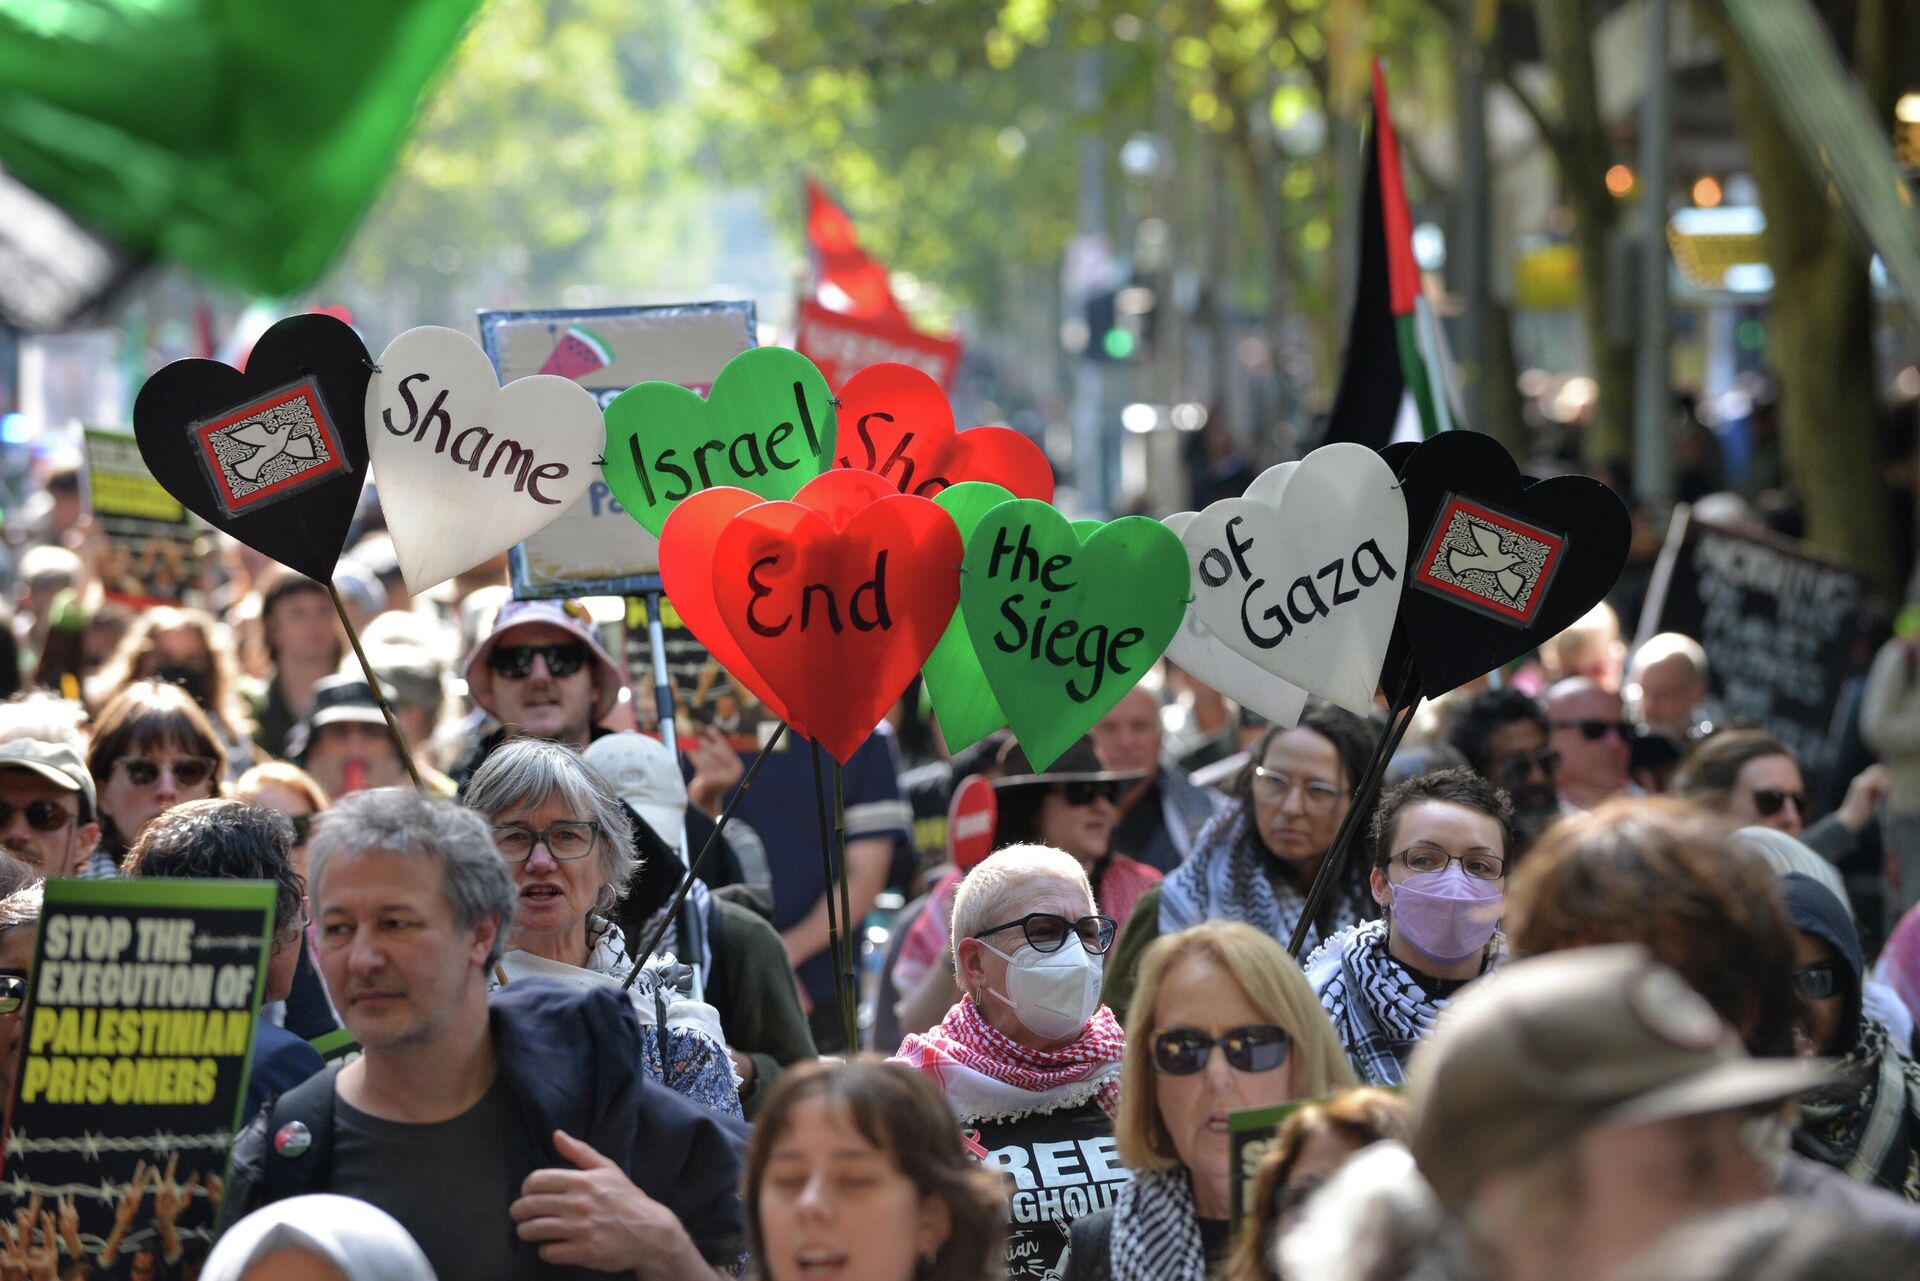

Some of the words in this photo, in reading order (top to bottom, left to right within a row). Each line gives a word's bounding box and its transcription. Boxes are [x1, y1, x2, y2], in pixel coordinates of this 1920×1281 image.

[382, 372, 570, 505] Shame
[629, 381, 822, 507] Israel
[988, 524, 1078, 591] the
[1198, 516, 1254, 588] of
[746, 549, 893, 638] End
[1240, 538, 1398, 650] Gaza
[993, 593, 1145, 704] Siege
[46, 915, 131, 960] STOP
[138, 919, 193, 962] THE
[38, 963, 213, 1006] EXECUTION
[217, 966, 254, 1007] OF
[31, 1009, 250, 1056] PALESTINIAN
[23, 1058, 217, 1103] PRISONERS
[978, 1136, 1134, 1190] REE
[1006, 1182, 1128, 1224] GHOUT
